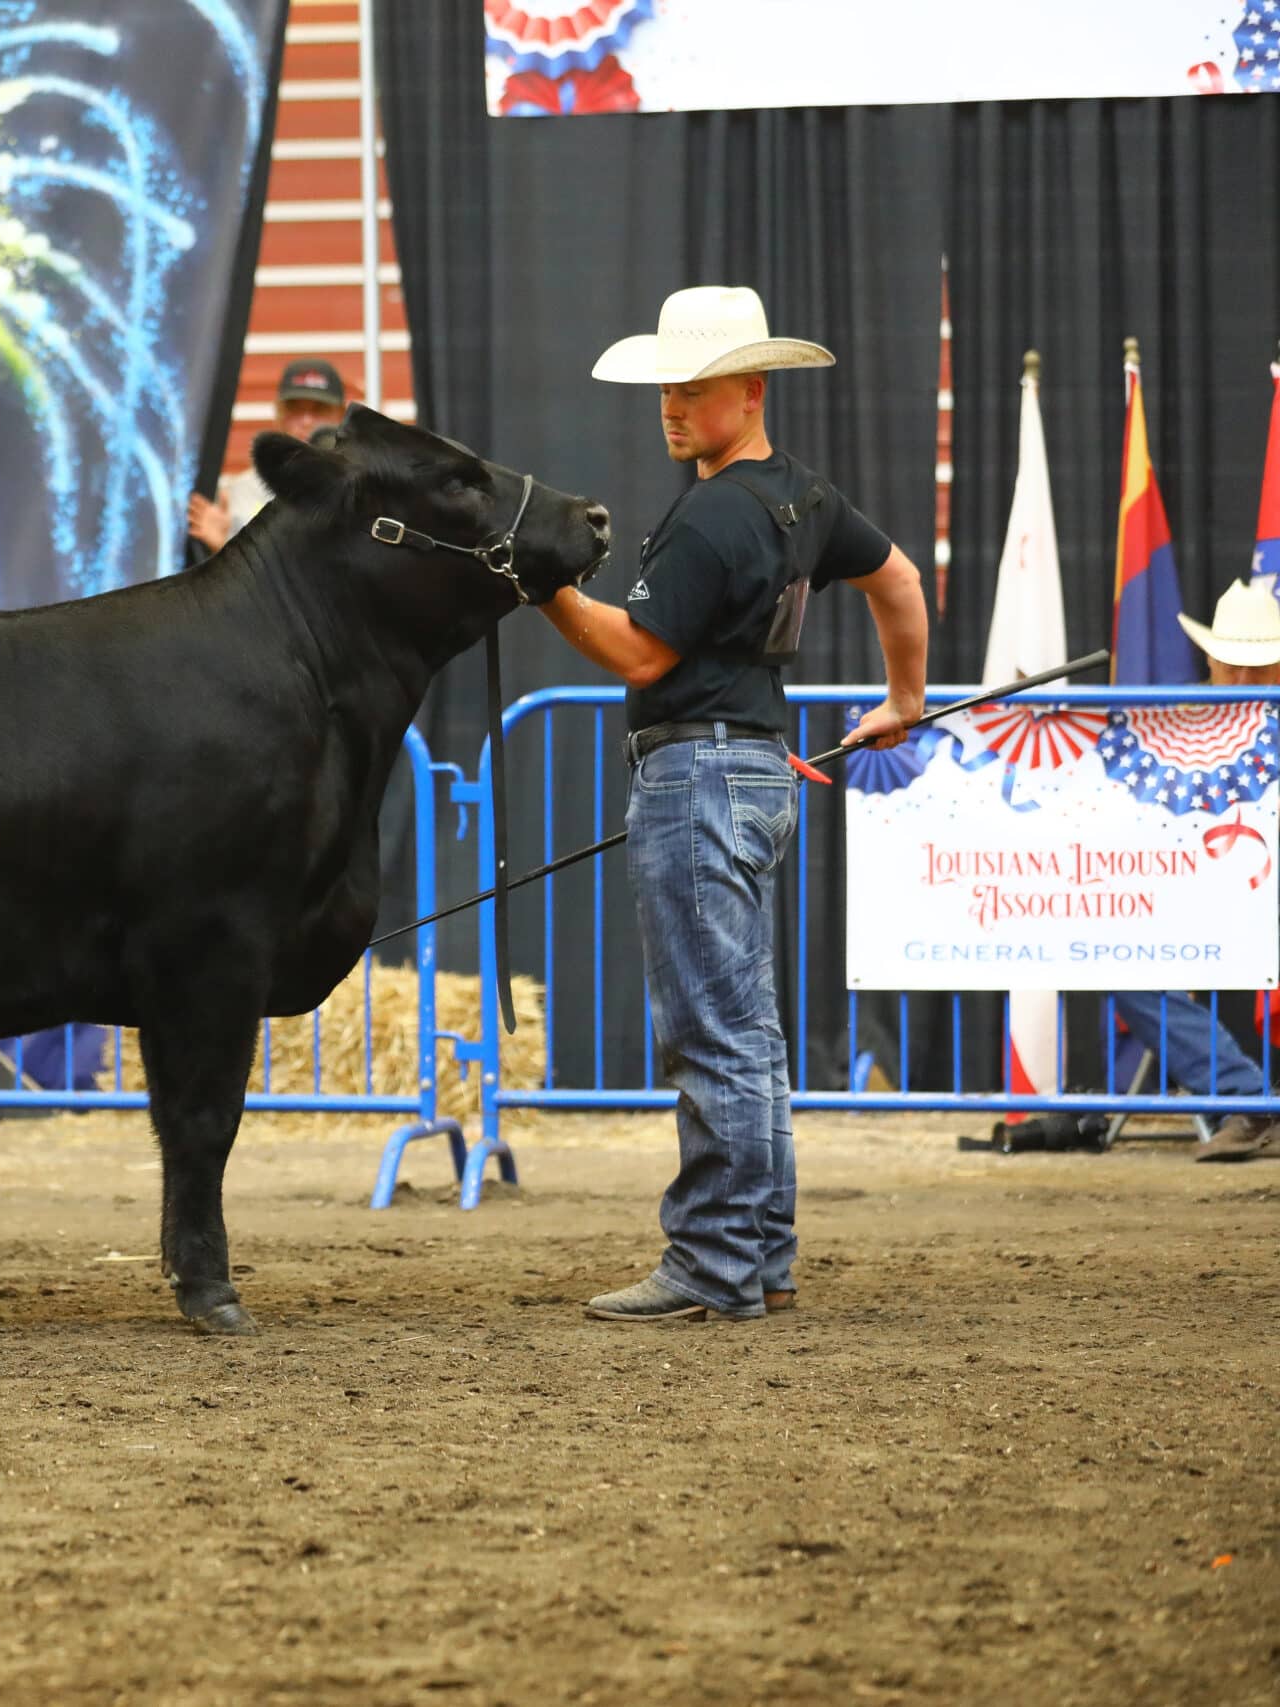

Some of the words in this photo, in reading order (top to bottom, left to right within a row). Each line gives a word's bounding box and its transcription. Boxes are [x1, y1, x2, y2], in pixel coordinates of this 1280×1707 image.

[922, 842, 1061, 886] LOUISIANA
[1068, 842, 1197, 886] LIMOUSIN
[969, 885, 1155, 930] ASSOCIATION
[904, 940, 1055, 961] GENERAL
[1068, 940, 1222, 961] SPONSOR
